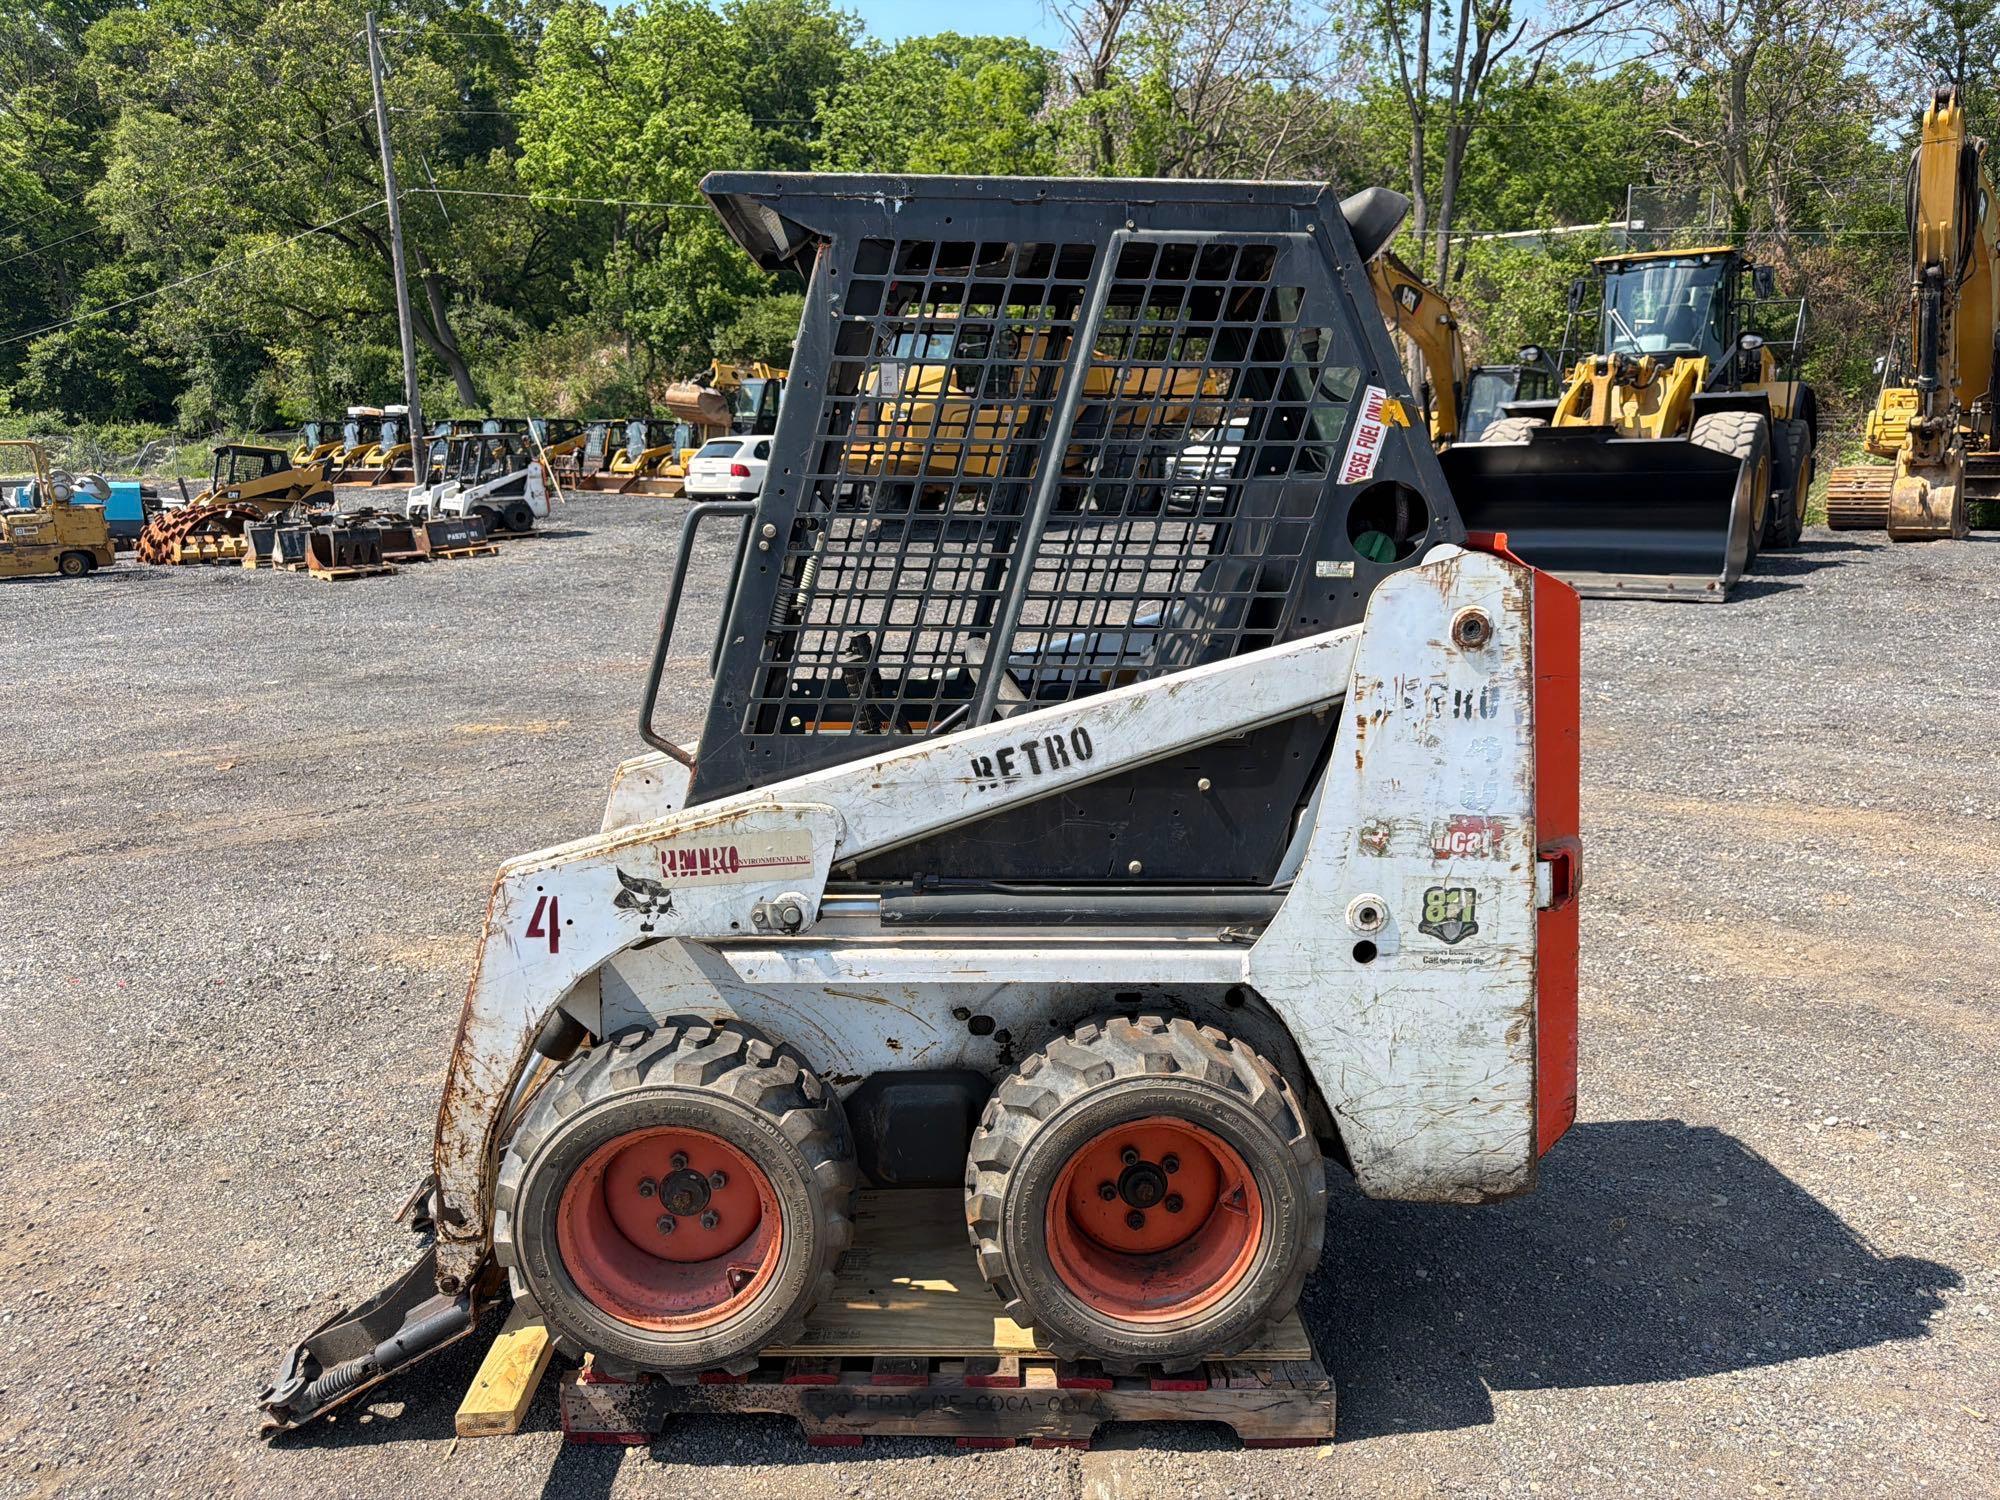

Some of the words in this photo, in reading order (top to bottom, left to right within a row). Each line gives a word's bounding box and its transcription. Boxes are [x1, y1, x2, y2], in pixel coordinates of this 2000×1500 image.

[1402, 286, 1417, 311] CAT
[1365, 392, 1385, 425] ONLY
[1357, 424, 1380, 451] FUEL
[1345, 451, 1372, 483] DIESEL
[227, 491, 239, 499] CAT
[971, 727, 1093, 792] RETRO
[734, 856, 795, 867] ENVIRONMENTAL
[526, 896, 561, 954] 4
